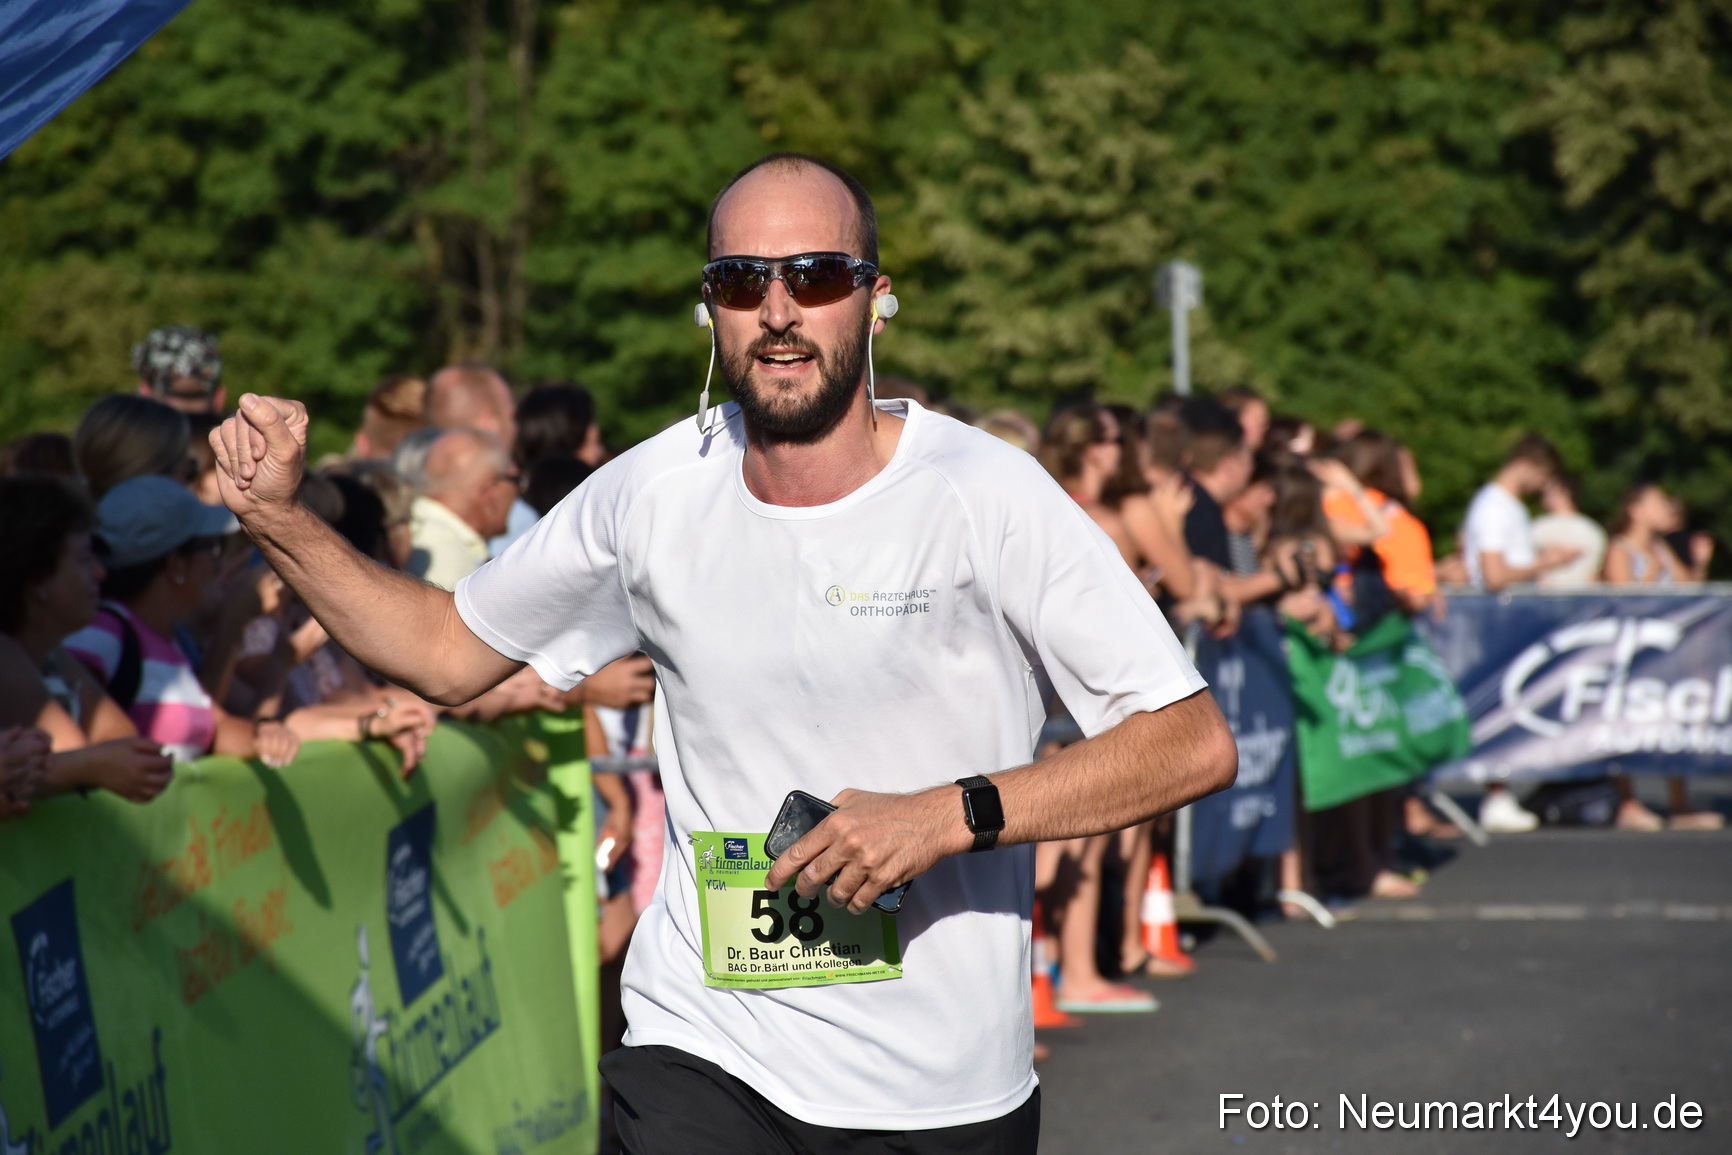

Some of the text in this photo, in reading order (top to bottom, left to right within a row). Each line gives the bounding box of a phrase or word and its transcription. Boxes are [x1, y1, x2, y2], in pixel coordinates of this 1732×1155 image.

[850, 589, 930, 602] DAS ÄRZTEHAUS
[850, 602, 930, 617] ORTHOPÄDIE
[751, 889, 824, 943] 58
[727, 943, 861, 960] Dr. Baur Christian
[728, 958, 862, 973] BAG Dr.Bärtl und Kollegen
